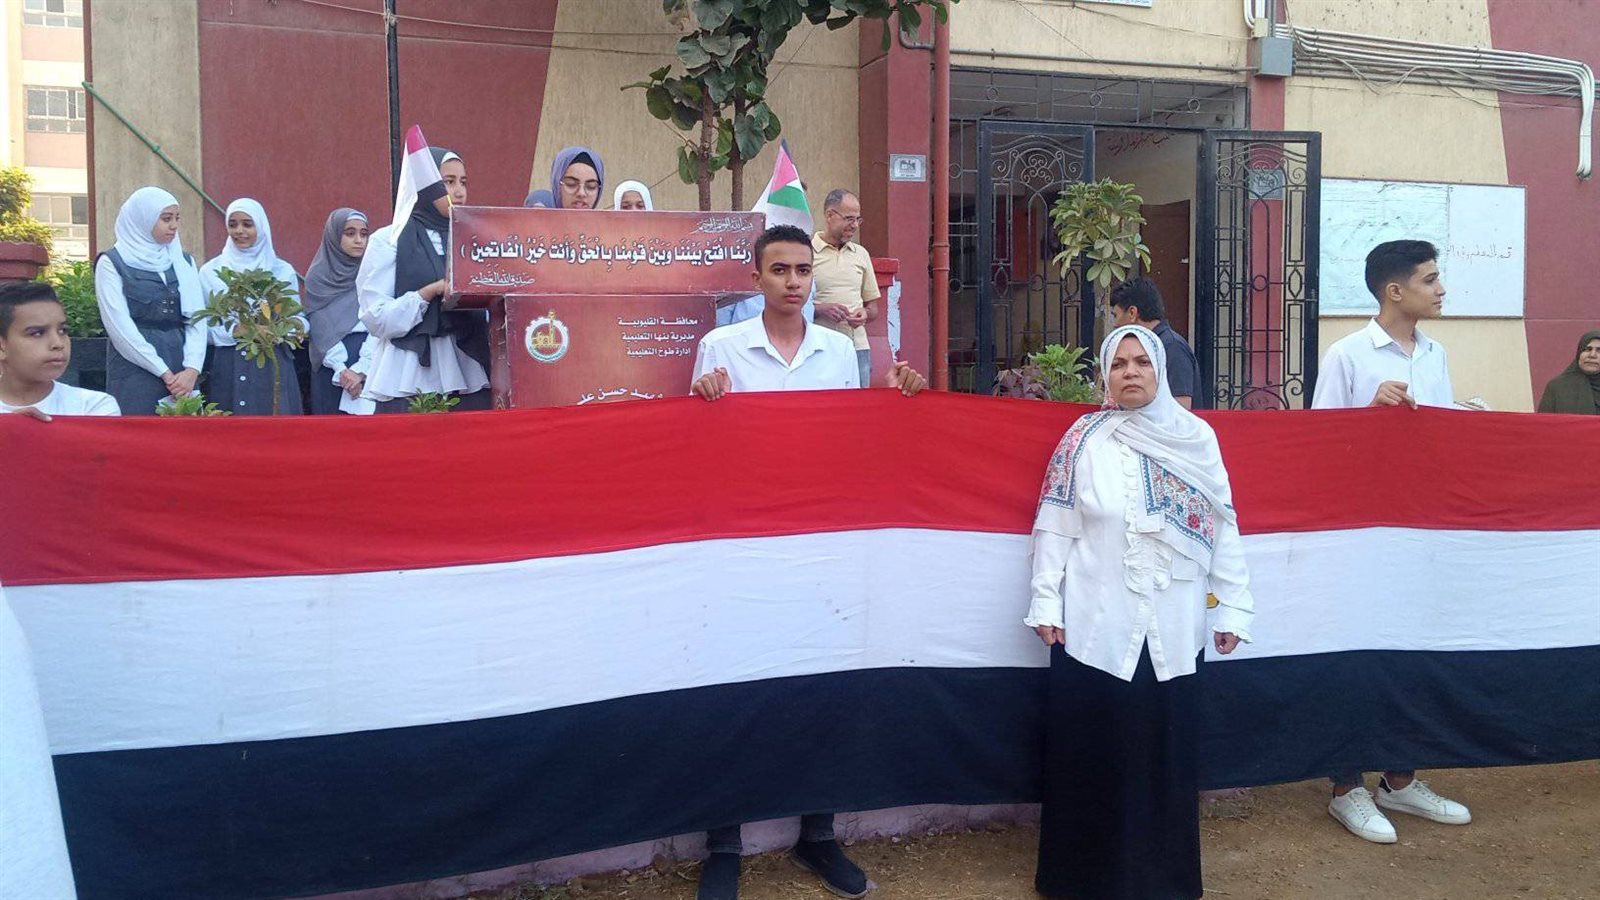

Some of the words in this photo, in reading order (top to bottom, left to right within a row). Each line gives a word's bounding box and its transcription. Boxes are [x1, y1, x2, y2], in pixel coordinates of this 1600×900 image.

[617, 316, 659, 328] القليوبية
[622, 332, 653, 343] التعليمية
[654, 333, 670, 342] بنها
[671, 332, 695, 342] مديرية
[627, 347, 657, 358] التعليمية
[658, 347, 675, 357] طوخ
[598, 388, 628, 401] حسن
